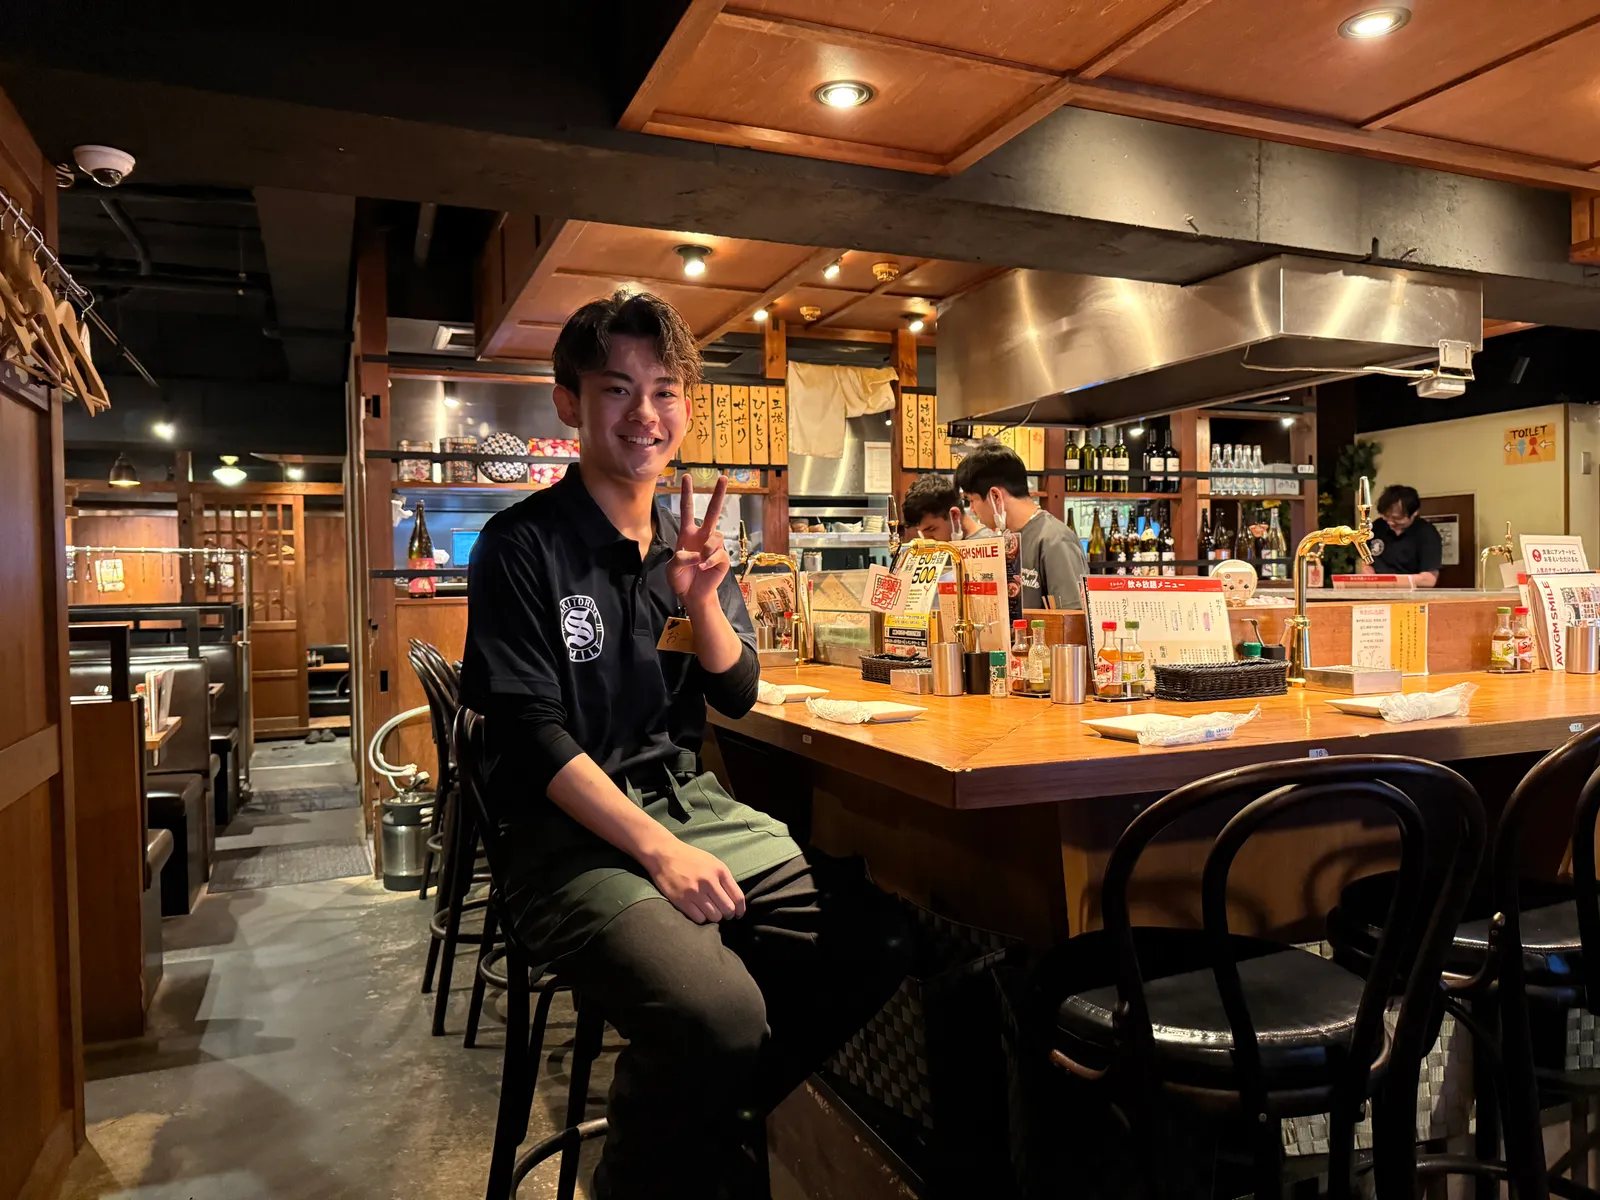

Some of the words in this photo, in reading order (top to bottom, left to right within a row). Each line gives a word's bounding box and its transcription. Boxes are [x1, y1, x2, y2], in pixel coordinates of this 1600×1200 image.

[696, 395, 709, 444] ささみ
[733, 398, 747, 443] せせり
[1509, 425, 1548, 440] TOILET
[971, 546, 999, 559] SMILE
[1127, 580, 1186, 589] 飲み放題メニュー
[1541, 580, 1559, 620] SMILE
[569, 641, 601, 660] MILE
[1551, 622, 1564, 667] AWGM
[1315, 749, 1323, 757] 16
